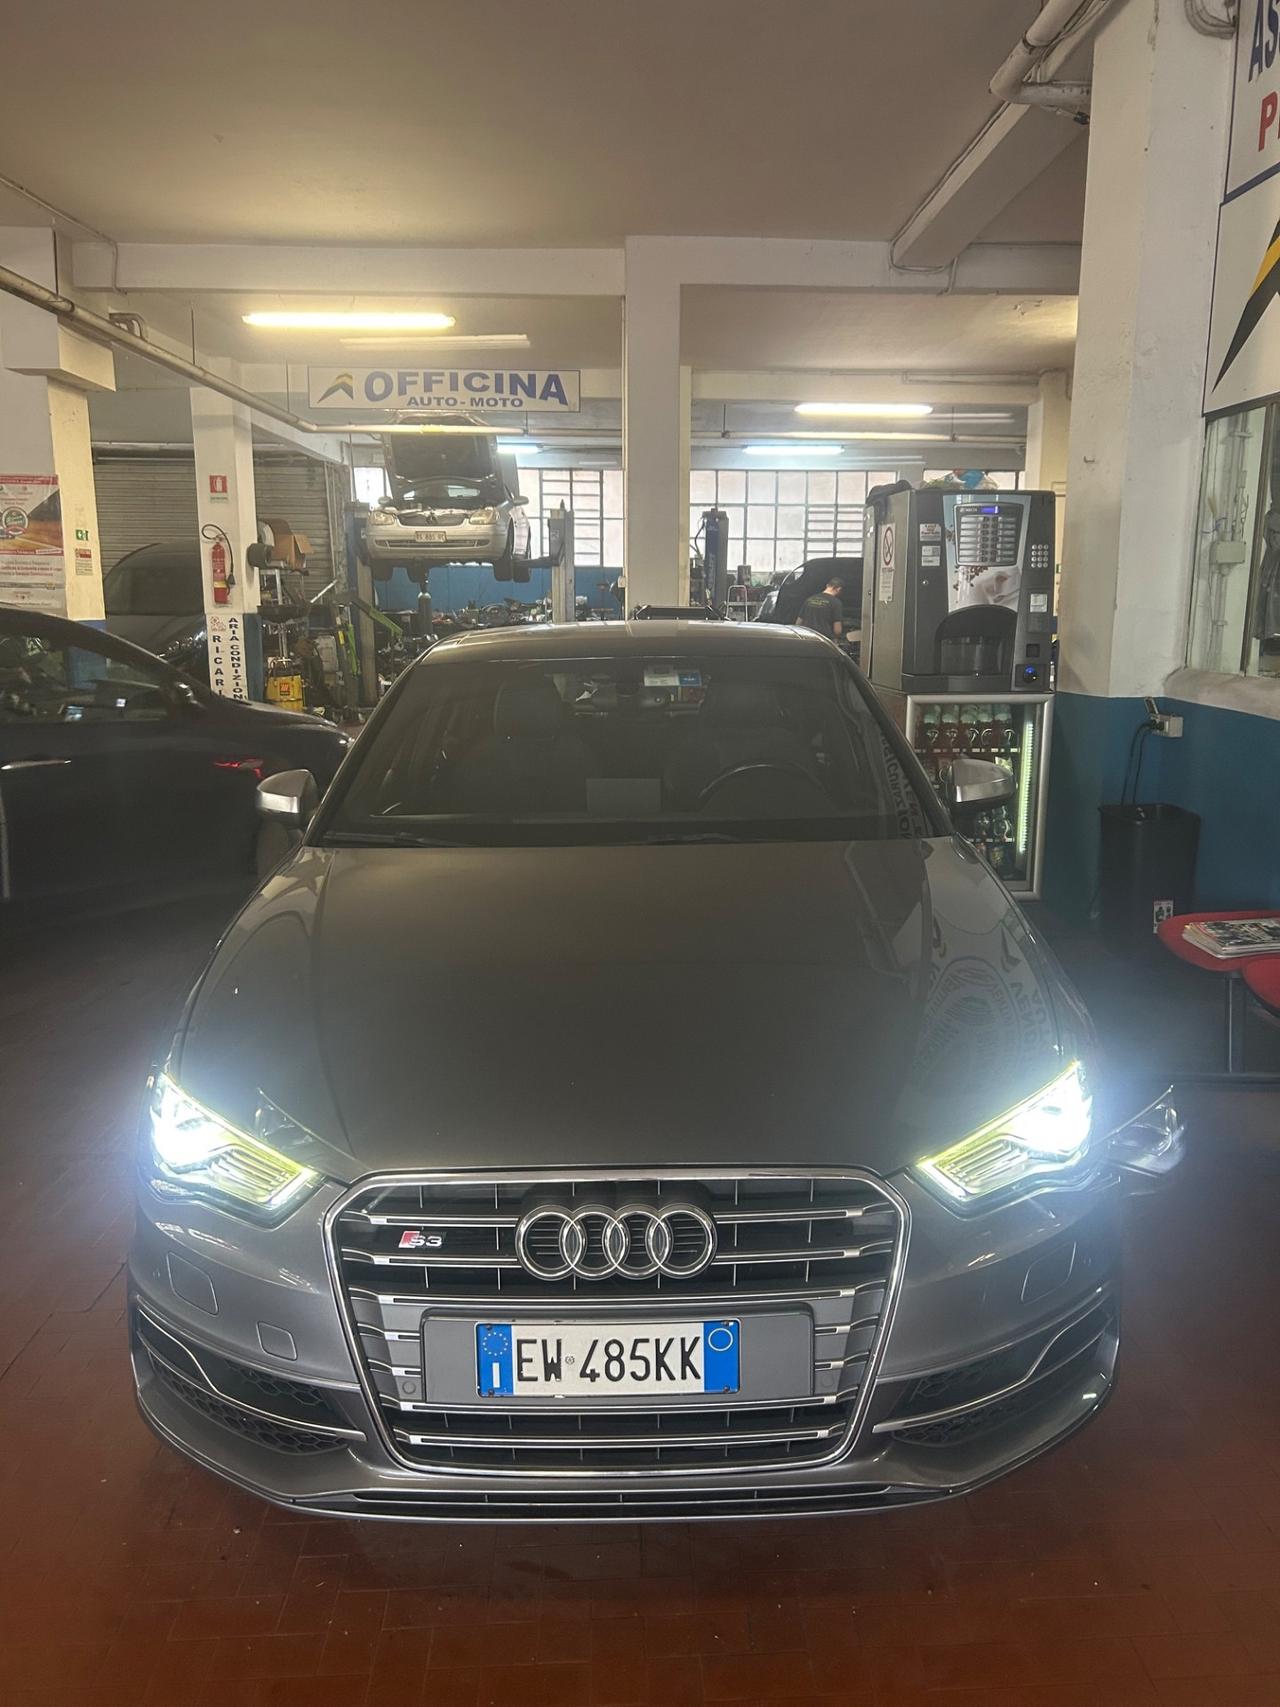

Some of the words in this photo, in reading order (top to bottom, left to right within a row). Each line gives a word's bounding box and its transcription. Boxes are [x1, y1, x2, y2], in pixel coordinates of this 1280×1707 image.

[1248, 0, 1280, 82] AS
[1258, 91, 1280, 152] P
[364, 371, 569, 406] OFFICINA
[228, 617, 239, 641] ARIA
[405, 1234, 442, 1247] S3
